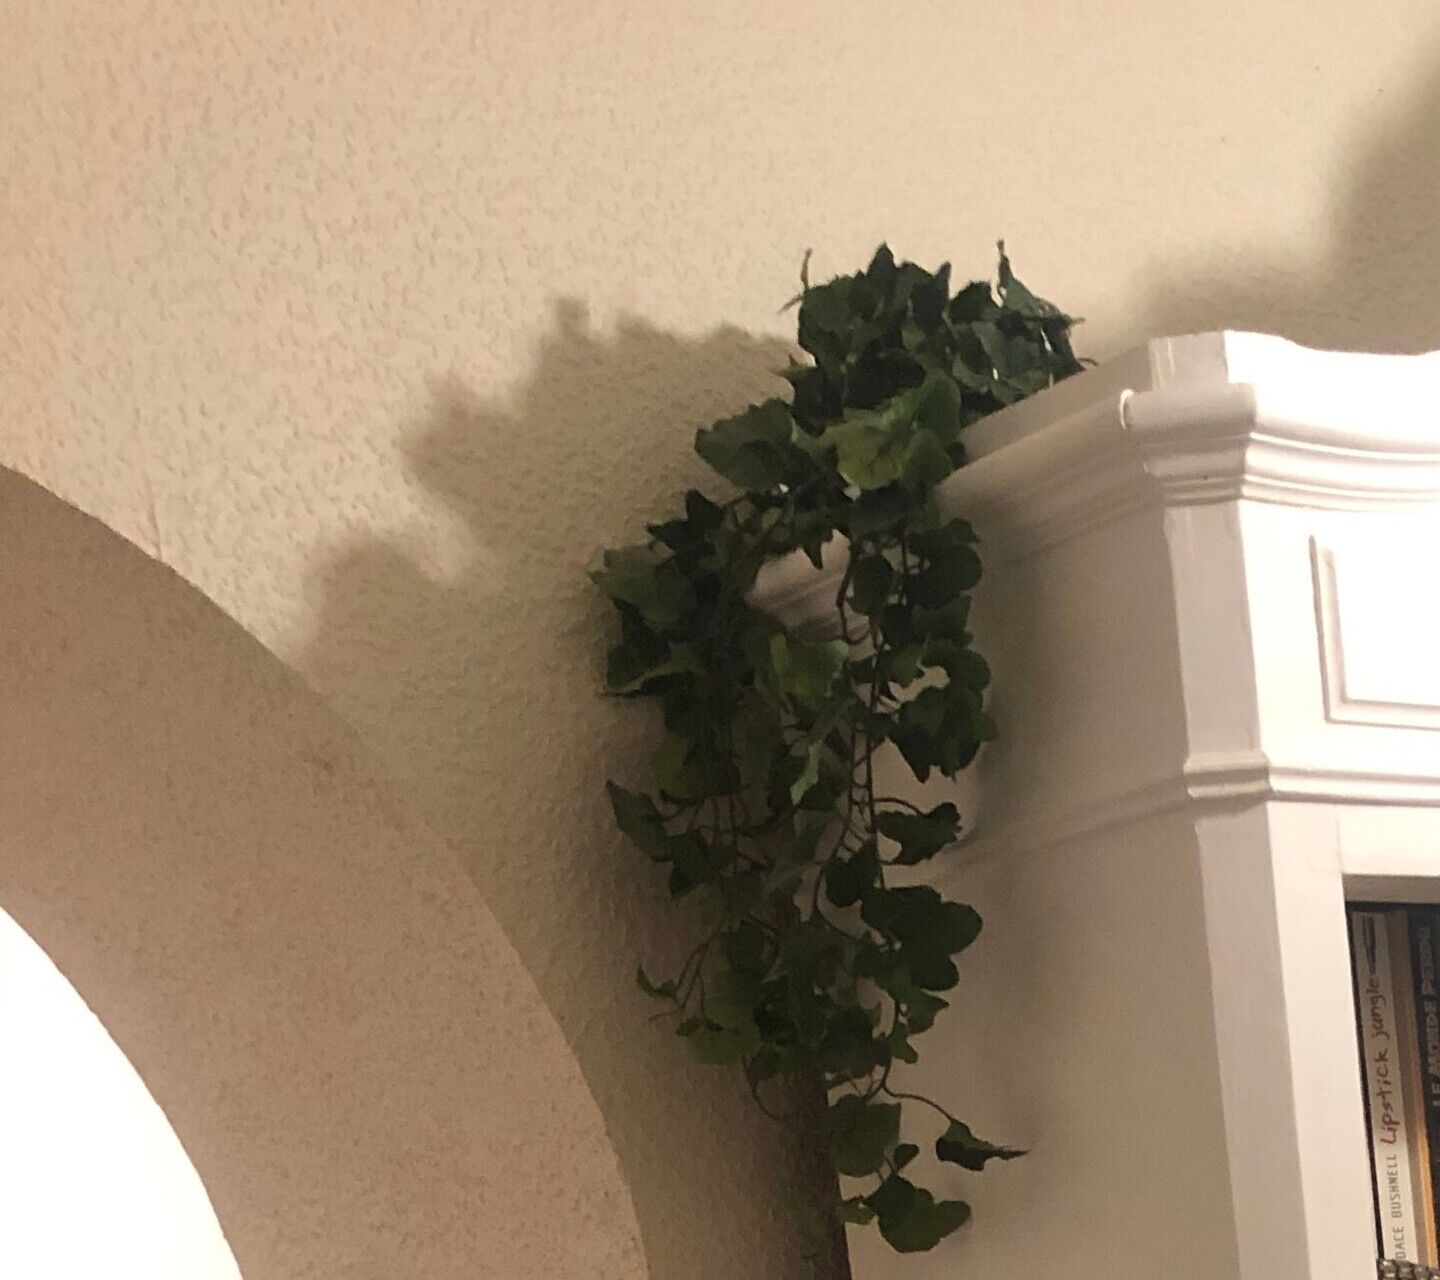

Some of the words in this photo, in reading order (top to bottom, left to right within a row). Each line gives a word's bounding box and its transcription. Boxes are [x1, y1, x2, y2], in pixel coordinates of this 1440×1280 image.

[1367, 976, 1390, 1041] jungle
[1374, 1048, 1401, 1145] Lipstick
[1386, 1153, 1403, 1218] BUSHNELL
